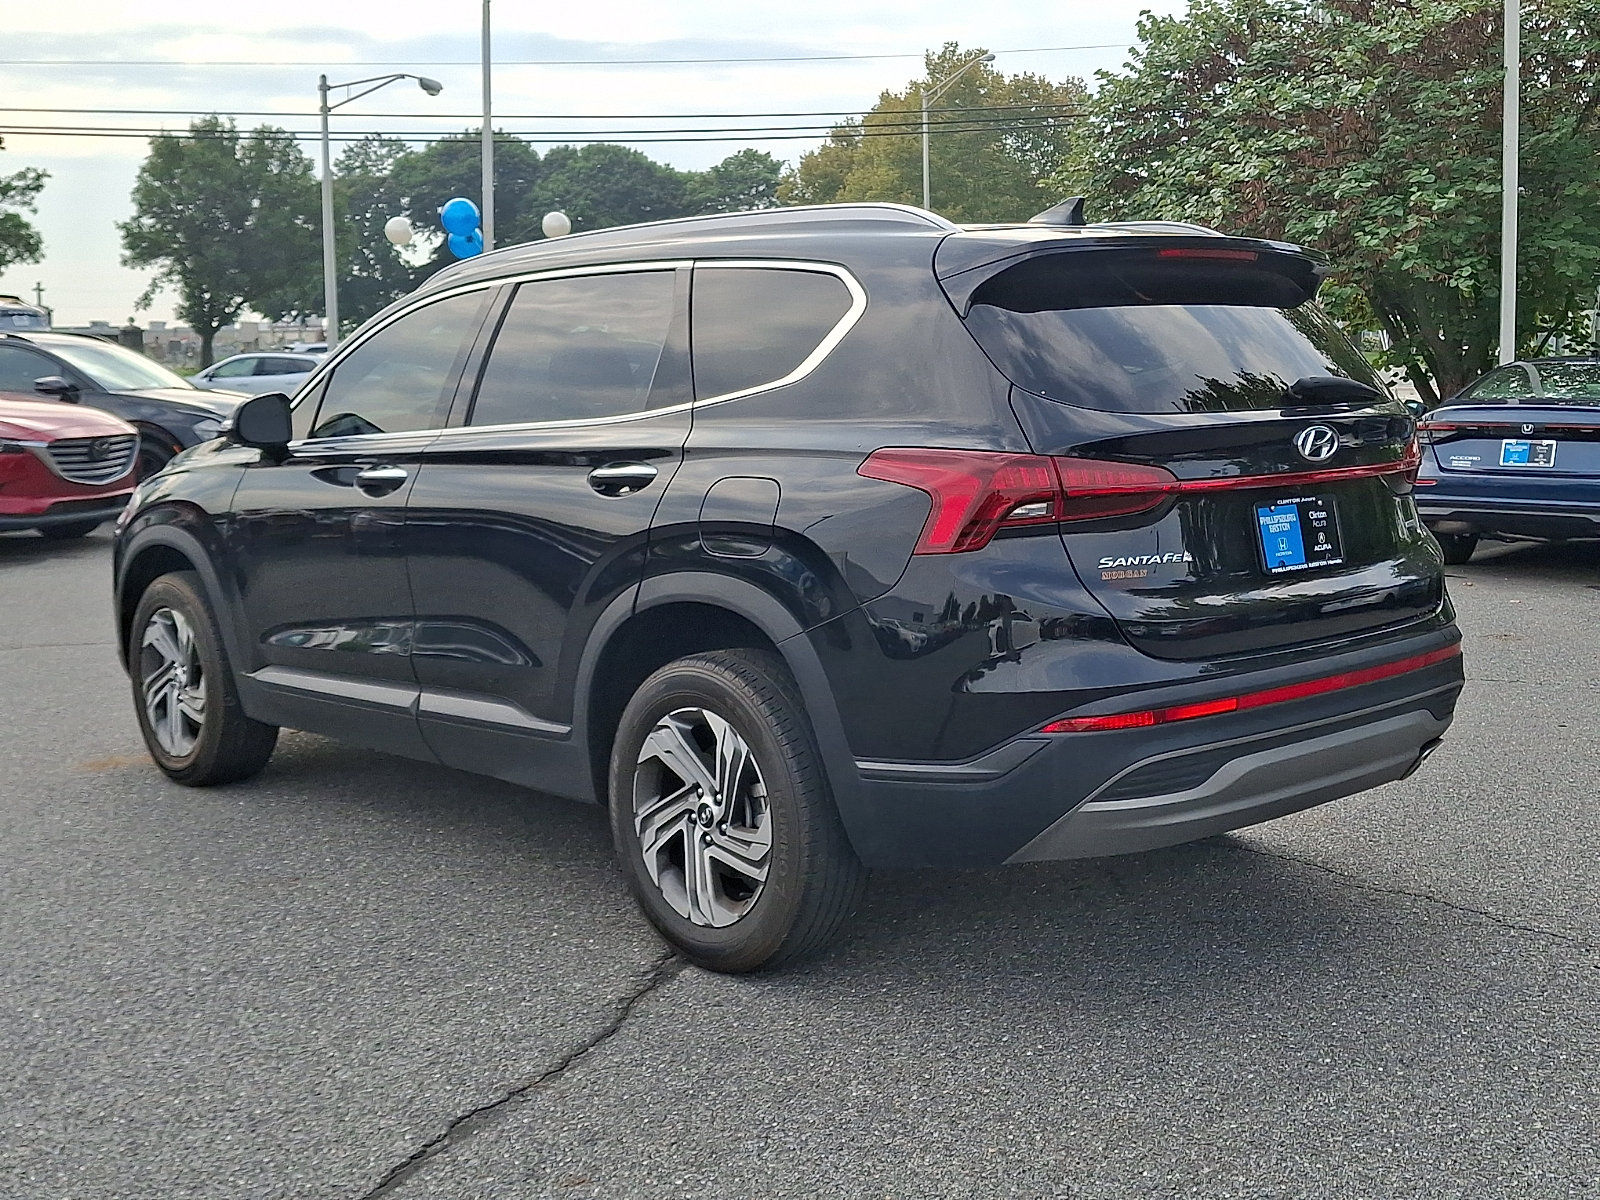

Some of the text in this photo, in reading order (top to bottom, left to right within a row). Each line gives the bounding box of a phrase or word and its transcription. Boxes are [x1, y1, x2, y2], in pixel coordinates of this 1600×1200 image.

[1269, 522, 1291, 533] EASTON
[1314, 543, 1332, 552] ACURA
[1101, 569, 1148, 580] MORGAN
